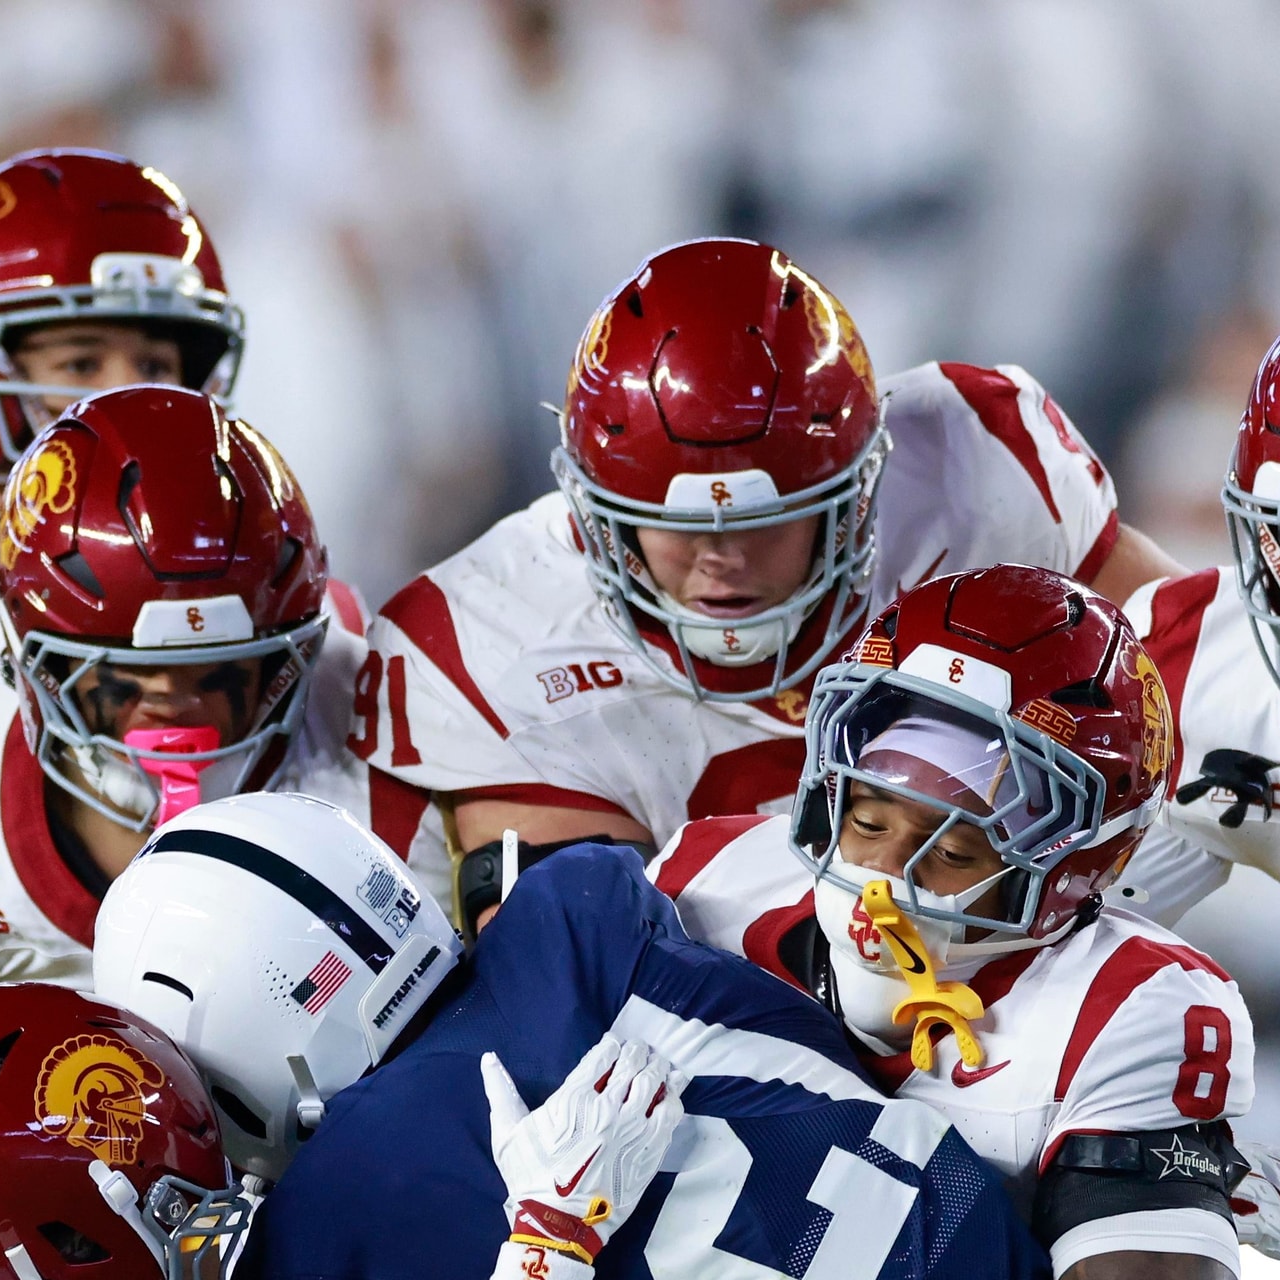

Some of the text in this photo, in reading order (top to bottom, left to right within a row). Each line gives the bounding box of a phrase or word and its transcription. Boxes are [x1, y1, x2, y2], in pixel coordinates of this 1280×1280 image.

[187, 606, 204, 632] SC
[723, 628, 741, 652] SC
[948, 658, 964, 684] SC
[346, 650, 423, 767] 91
[373, 973, 417, 1029] NITTANY
[1170, 1004, 1233, 1120] 8
